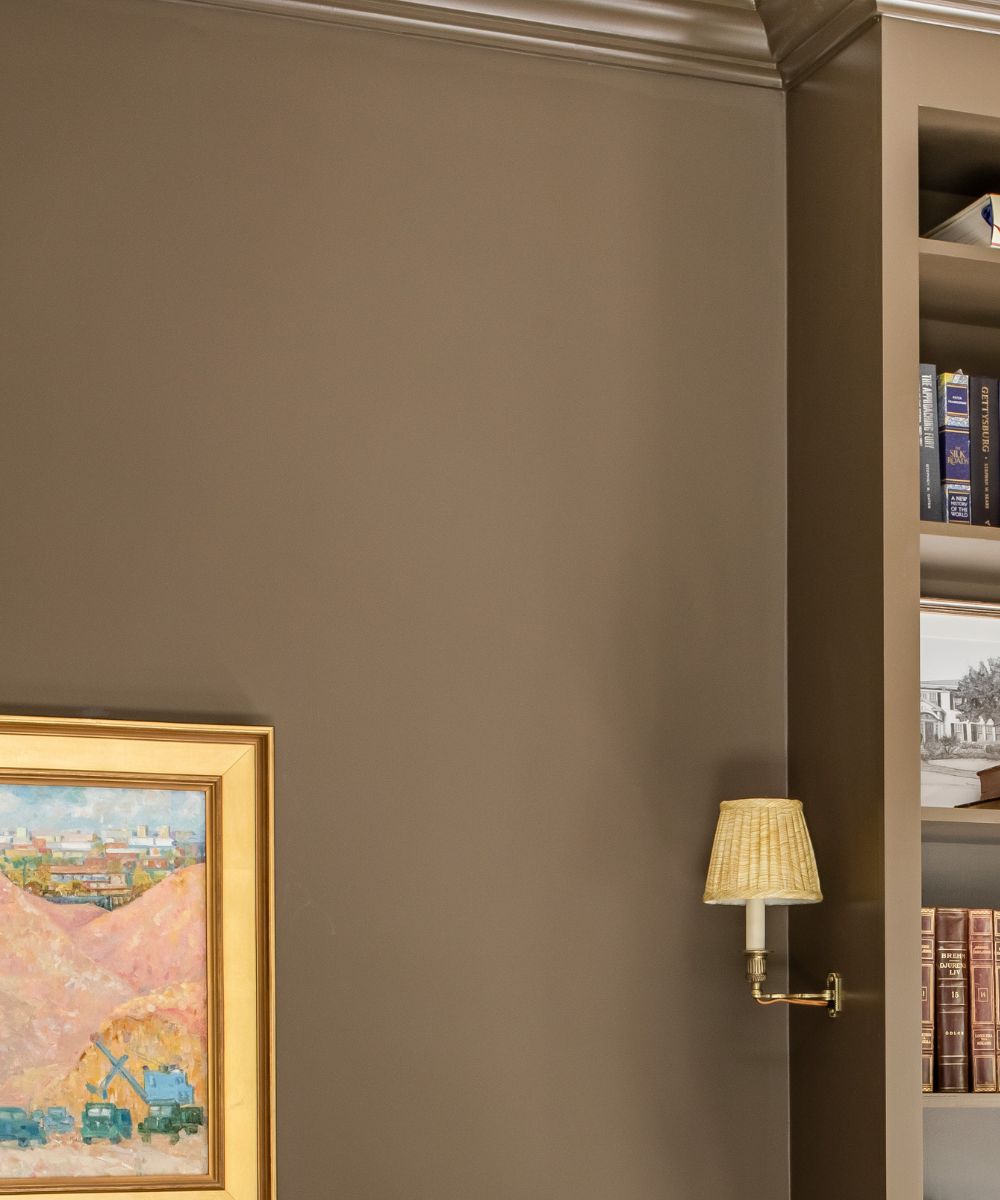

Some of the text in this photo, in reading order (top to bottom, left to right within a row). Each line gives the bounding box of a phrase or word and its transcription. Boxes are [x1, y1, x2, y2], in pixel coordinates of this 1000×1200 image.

[921, 374, 935, 448] THE APPROACHING FURY
[981, 386, 990, 453] GETTYSBURG
[950, 448, 967, 458] SILK
[947, 457, 969, 465] ROADS
[951, 991, 960, 999] 15
